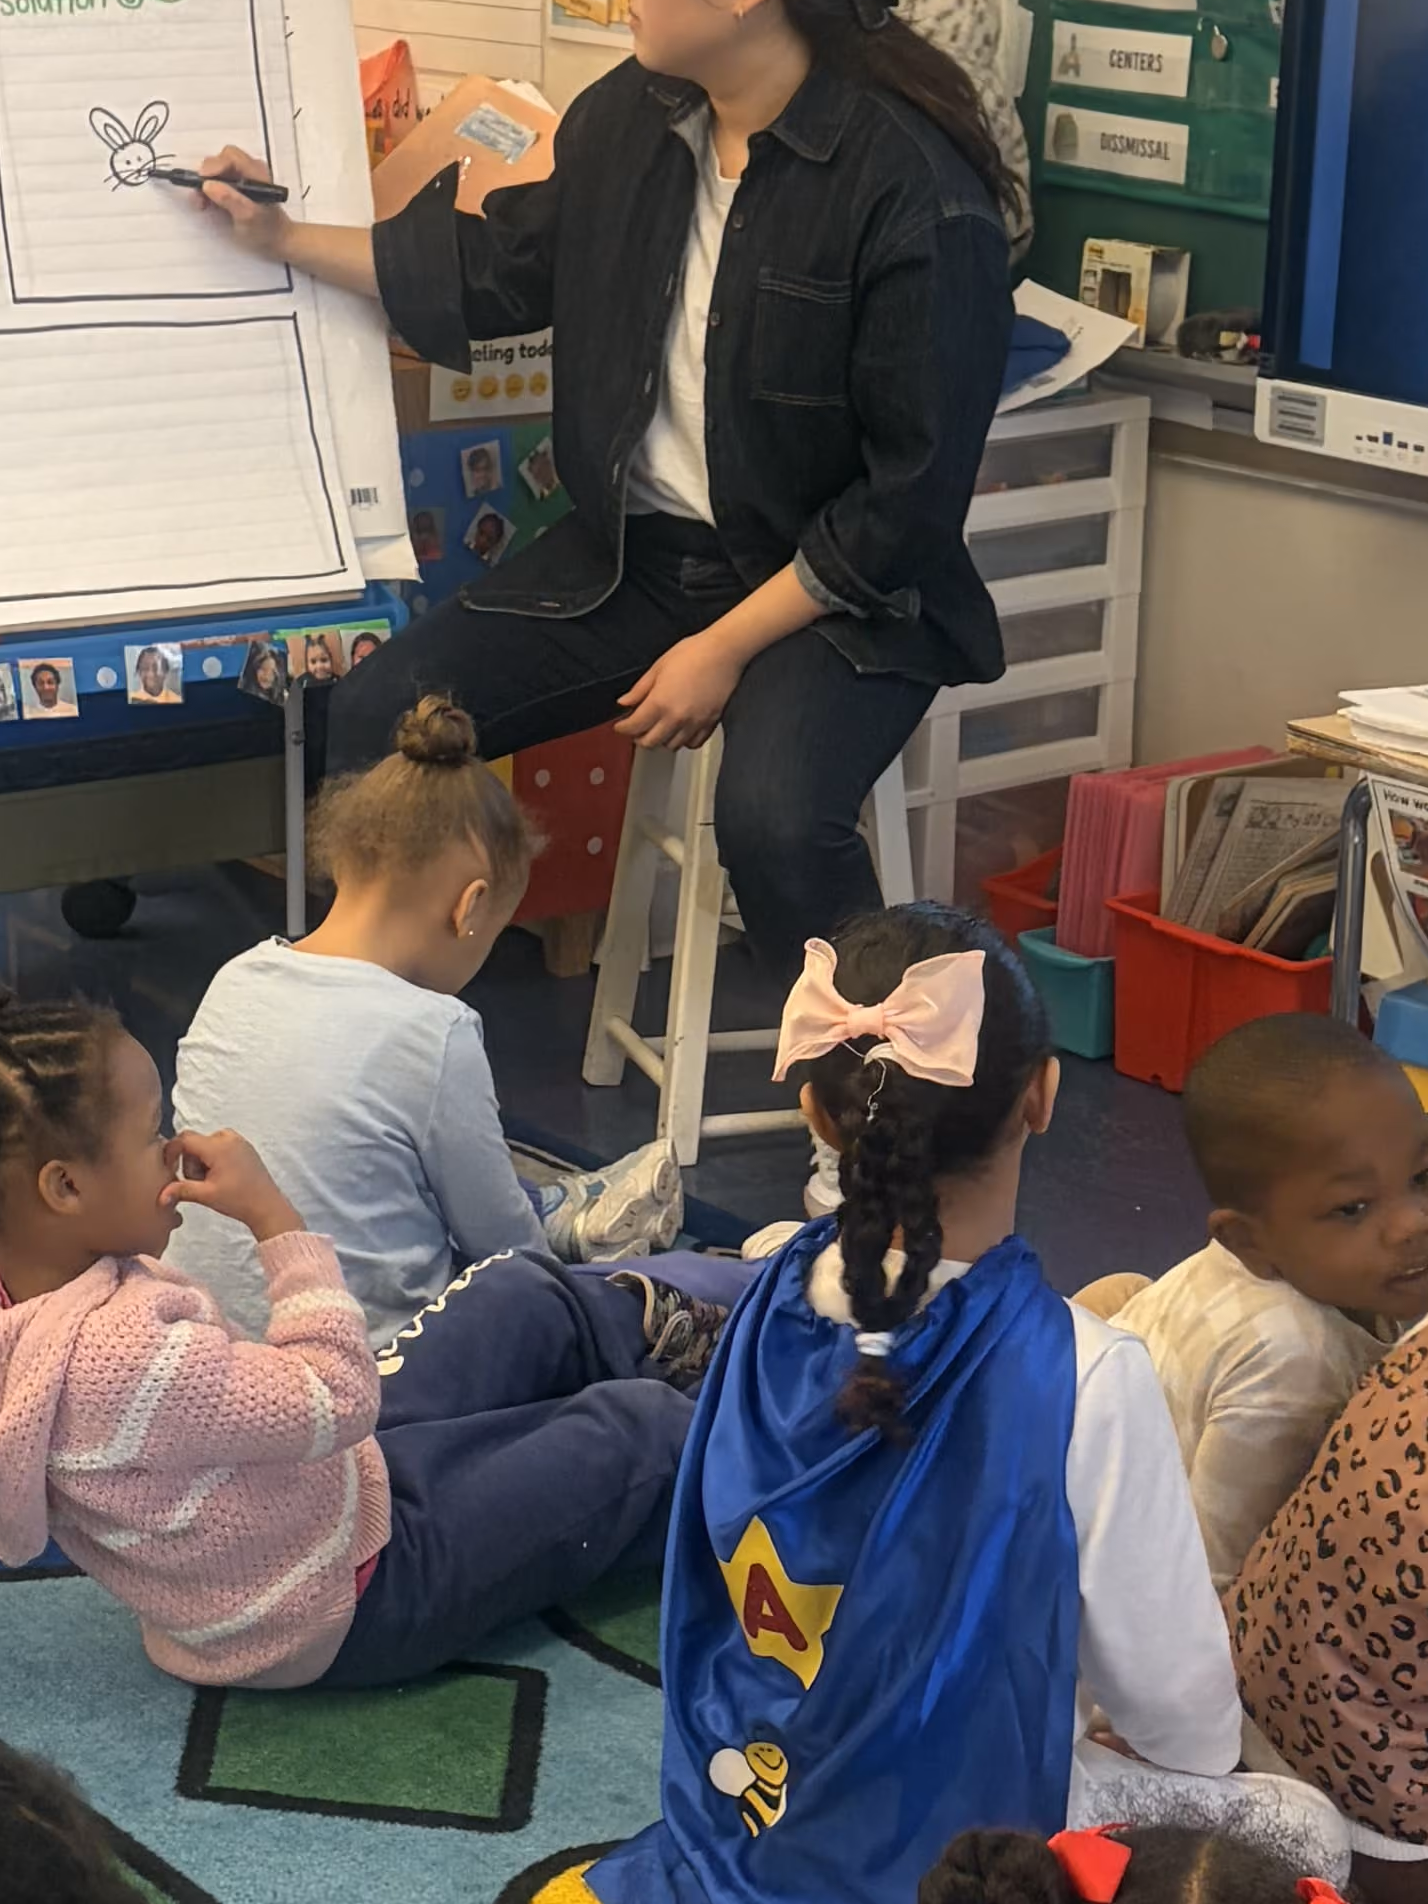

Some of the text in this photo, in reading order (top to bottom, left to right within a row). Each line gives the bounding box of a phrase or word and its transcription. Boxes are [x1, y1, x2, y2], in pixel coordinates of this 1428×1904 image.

[1109, 49, 1162, 72] CENTERS
[1384, 790, 1409, 805] How
[743, 1563, 808, 1652] A
